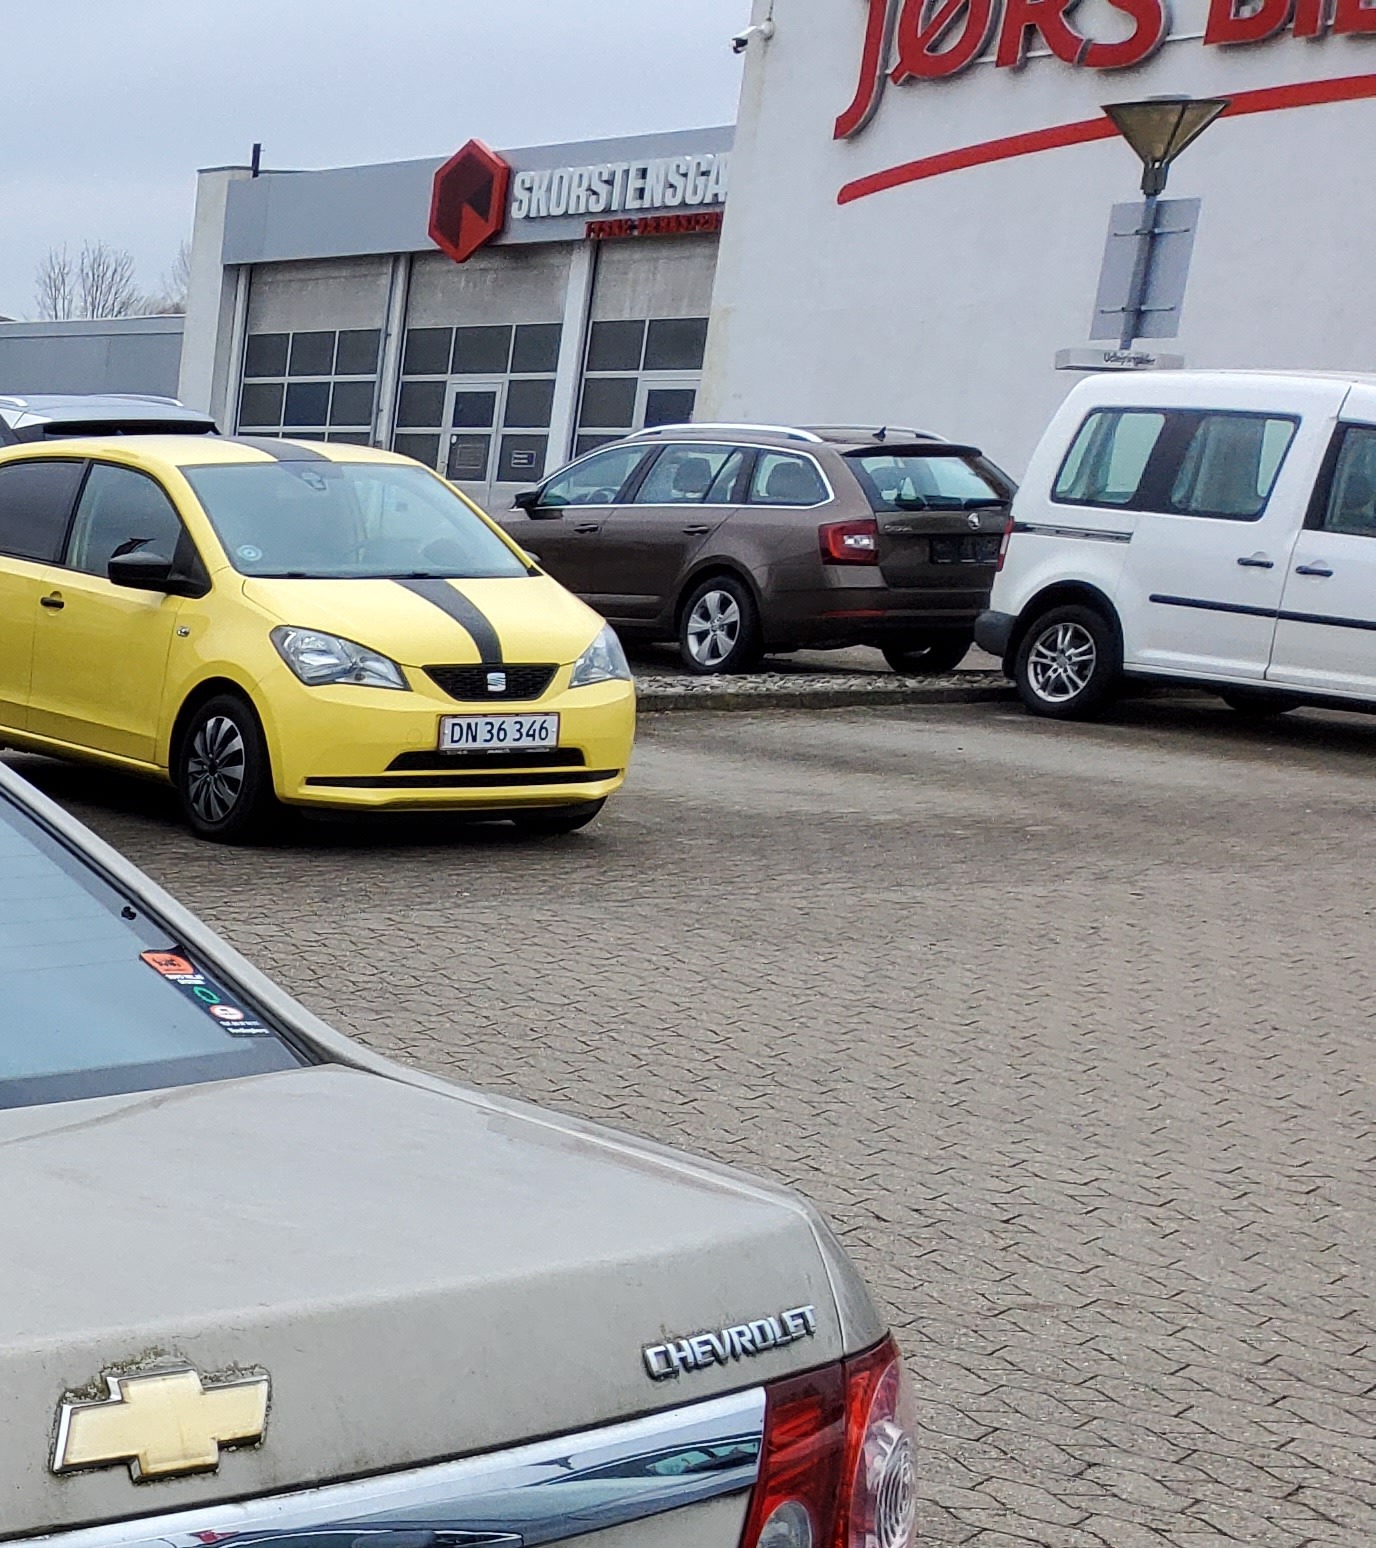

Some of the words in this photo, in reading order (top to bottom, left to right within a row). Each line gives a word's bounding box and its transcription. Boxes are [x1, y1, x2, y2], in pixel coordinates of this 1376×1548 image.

[450, 721, 478, 743] DN
[482, 720, 507, 742] 36
[512, 719, 549, 742] 346
[644, 1304, 817, 1380] CHEVROLET
